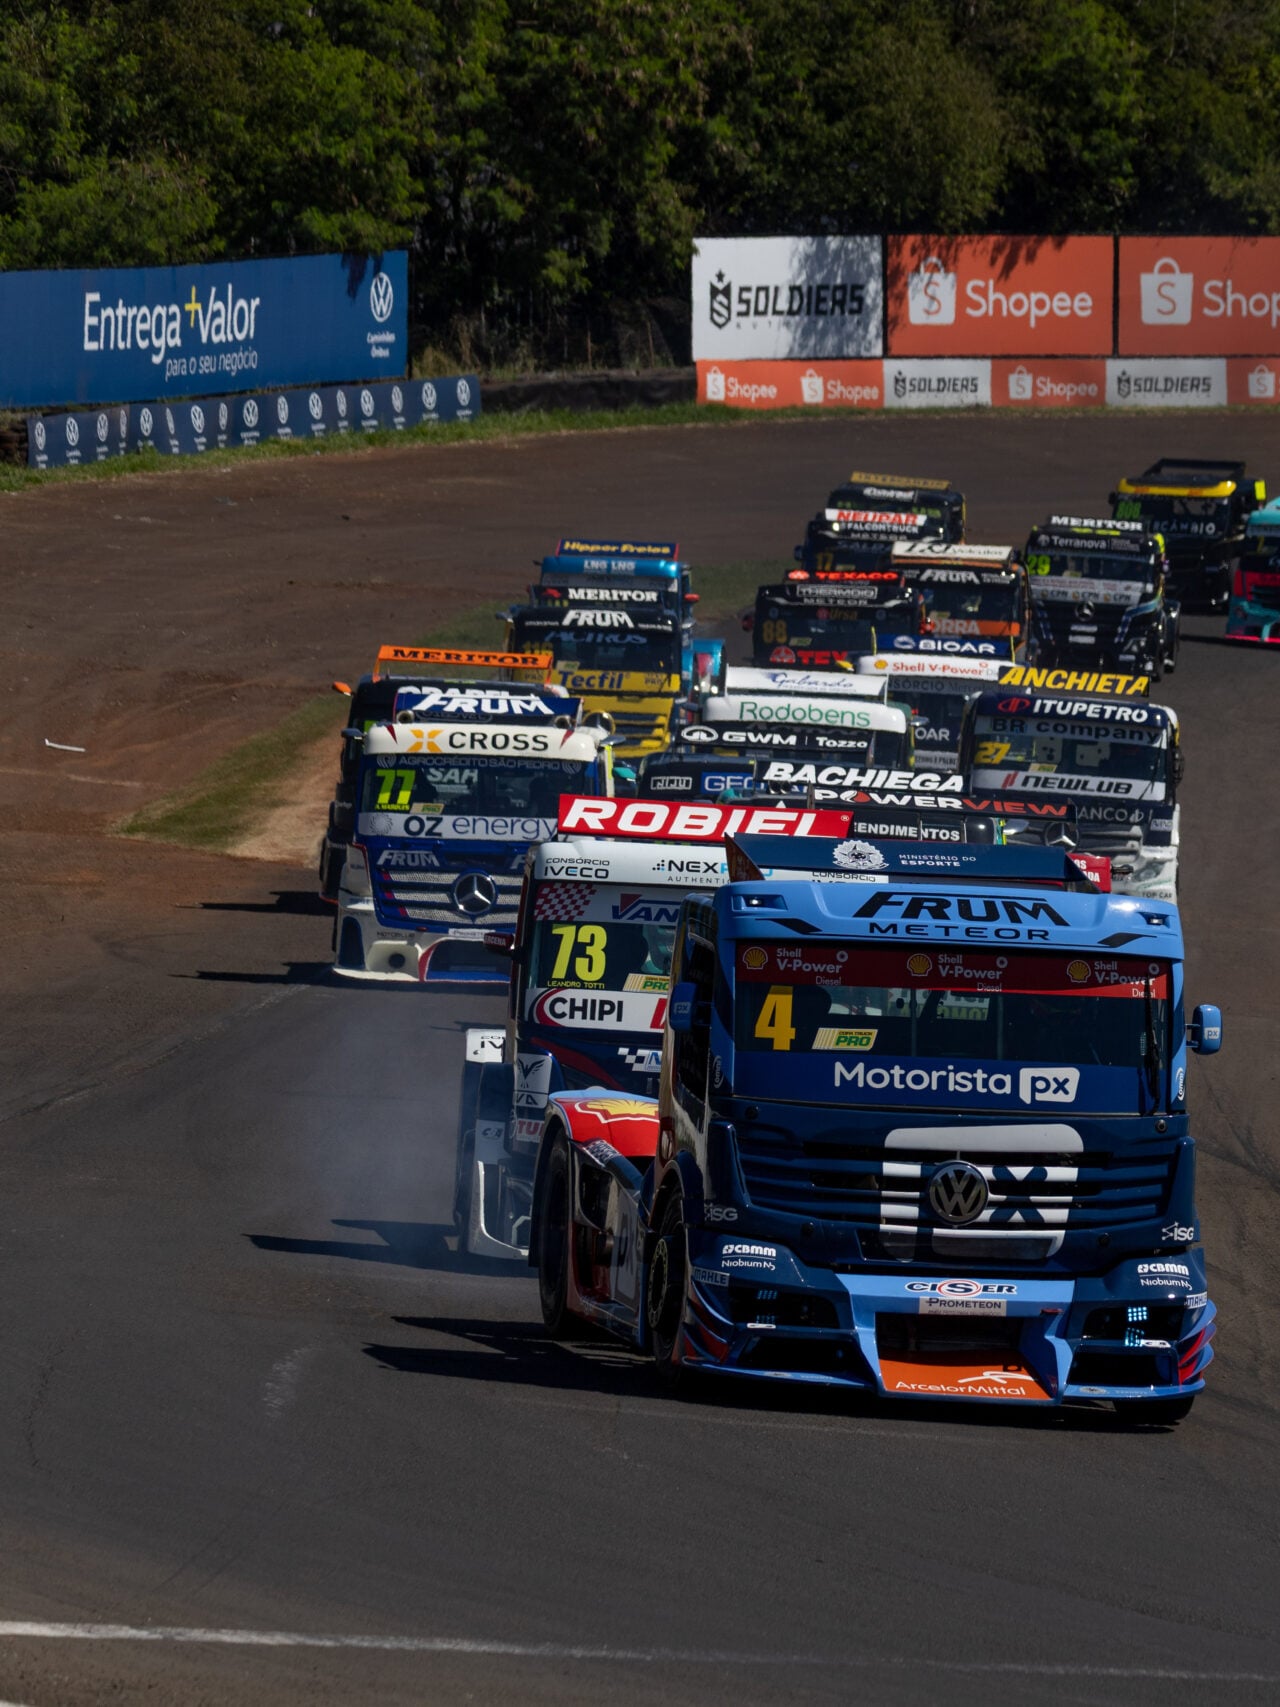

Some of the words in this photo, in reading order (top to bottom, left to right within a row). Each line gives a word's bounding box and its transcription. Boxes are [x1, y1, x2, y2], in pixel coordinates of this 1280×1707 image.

[736, 283, 865, 317] SOLDIERS
[965, 279, 1094, 328] Shopee
[83, 290, 182, 366] Entrega
[199, 282, 261, 344] Valor
[165, 354, 188, 383] para
[188, 356, 198, 374] o
[198, 354, 217, 375] seu
[218, 345, 259, 377] negócio
[726, 376, 778, 403] Shopee
[827, 379, 880, 404] Shopee
[908, 376, 979, 394] SOLDIERS
[1036, 376, 1098, 404] Shopee
[1133, 376, 1212, 395] SOLDIERS
[837, 511, 918, 525] NEUPAR
[1051, 515, 1143, 531] MERITOR
[1051, 535, 1106, 550] Terranova
[1027, 555, 1051, 576] 29
[815, 571, 899, 582] TEXACO
[919, 568, 981, 585] FRUM
[568, 588, 658, 602] MERITOR
[562, 609, 635, 629] FRUM
[544, 631, 648, 645] ACTROS
[762, 618, 788, 644] 88
[918, 638, 996, 655] BIOAR
[393, 649, 539, 665] MERITOR
[892, 662, 926, 673] Shell
[928, 664, 984, 677] V-Power
[558, 671, 625, 690] Tecfil
[999, 667, 1150, 696] ANCHIETA
[412, 693, 555, 715] FRUM
[1023, 699, 1149, 723] ITUPETRO
[739, 701, 871, 728] Rodobens
[992, 718, 1026, 733] BR
[1026, 722, 1161, 743] company
[449, 731, 549, 752] CROSS
[722, 731, 797, 746] GWM
[816, 737, 868, 749] Tozzo
[974, 742, 1011, 765] 27
[399, 757, 487, 769] AGROCRÉDITO
[488, 757, 517, 769] SÃO
[517, 761, 560, 771] PEDRO
[764, 762, 965, 792] BACHIEGA
[1021, 775, 1133, 795] NEWLUB
[376, 769, 416, 806] 77
[562, 799, 838, 838] ROBIEL
[404, 815, 443, 837] OZ
[452, 816, 559, 841] energy
[376, 850, 440, 868] FRUM
[546, 857, 611, 866] CONSÓRCIO
[899, 854, 958, 862] MINISTÉRIO
[544, 866, 609, 879] IVECO
[853, 891, 1072, 926] FRUM
[869, 922, 1050, 940] METEOR
[552, 924, 608, 982] 73
[776, 948, 802, 958] Shell
[938, 954, 963, 964] Shell
[776, 958, 843, 973] V-Power
[938, 965, 1002, 980] V-Power
[1094, 961, 1118, 971] Shell
[816, 975, 842, 985] Diesel
[976, 983, 1002, 991] Diesel
[1094, 971, 1156, 986] V-Power
[549, 998, 623, 1022] CHIPI
[754, 985, 796, 1051] 4
[835, 1036, 871, 1047] PRO
[834, 1061, 1012, 1095] Motorista
[1029, 1075, 1070, 1102] px
[907, 1280, 1017, 1295] CISER
[928, 1298, 1001, 1309] PROMETEON
[896, 1381, 1026, 1396] ArcelorMittal
